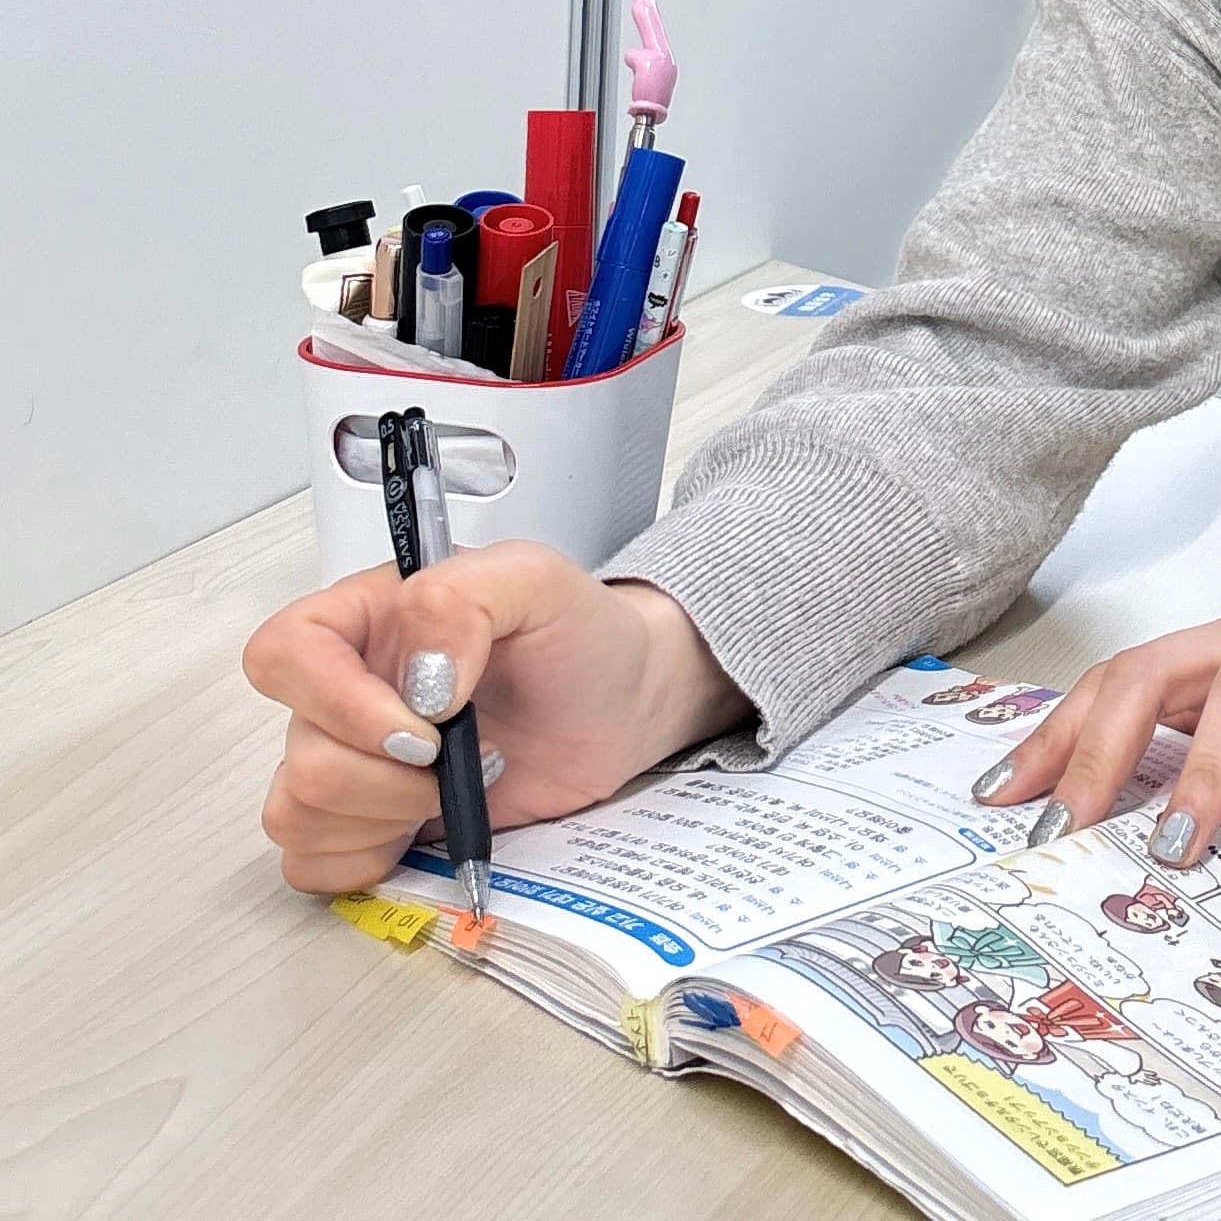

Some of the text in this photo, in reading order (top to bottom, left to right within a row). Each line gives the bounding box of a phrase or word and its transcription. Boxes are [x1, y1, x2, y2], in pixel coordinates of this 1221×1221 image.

[811, 828, 846, 840] 소영
[705, 844, 762, 863] 있어요?
[768, 847, 815, 867] 여기서
[693, 873, 740, 893] 거리도
[717, 864, 766, 884] 천천히
[572, 899, 612, 918] 싶은
[638, 891, 685, 911] 여기가
[606, 912, 645, 931] 가고
